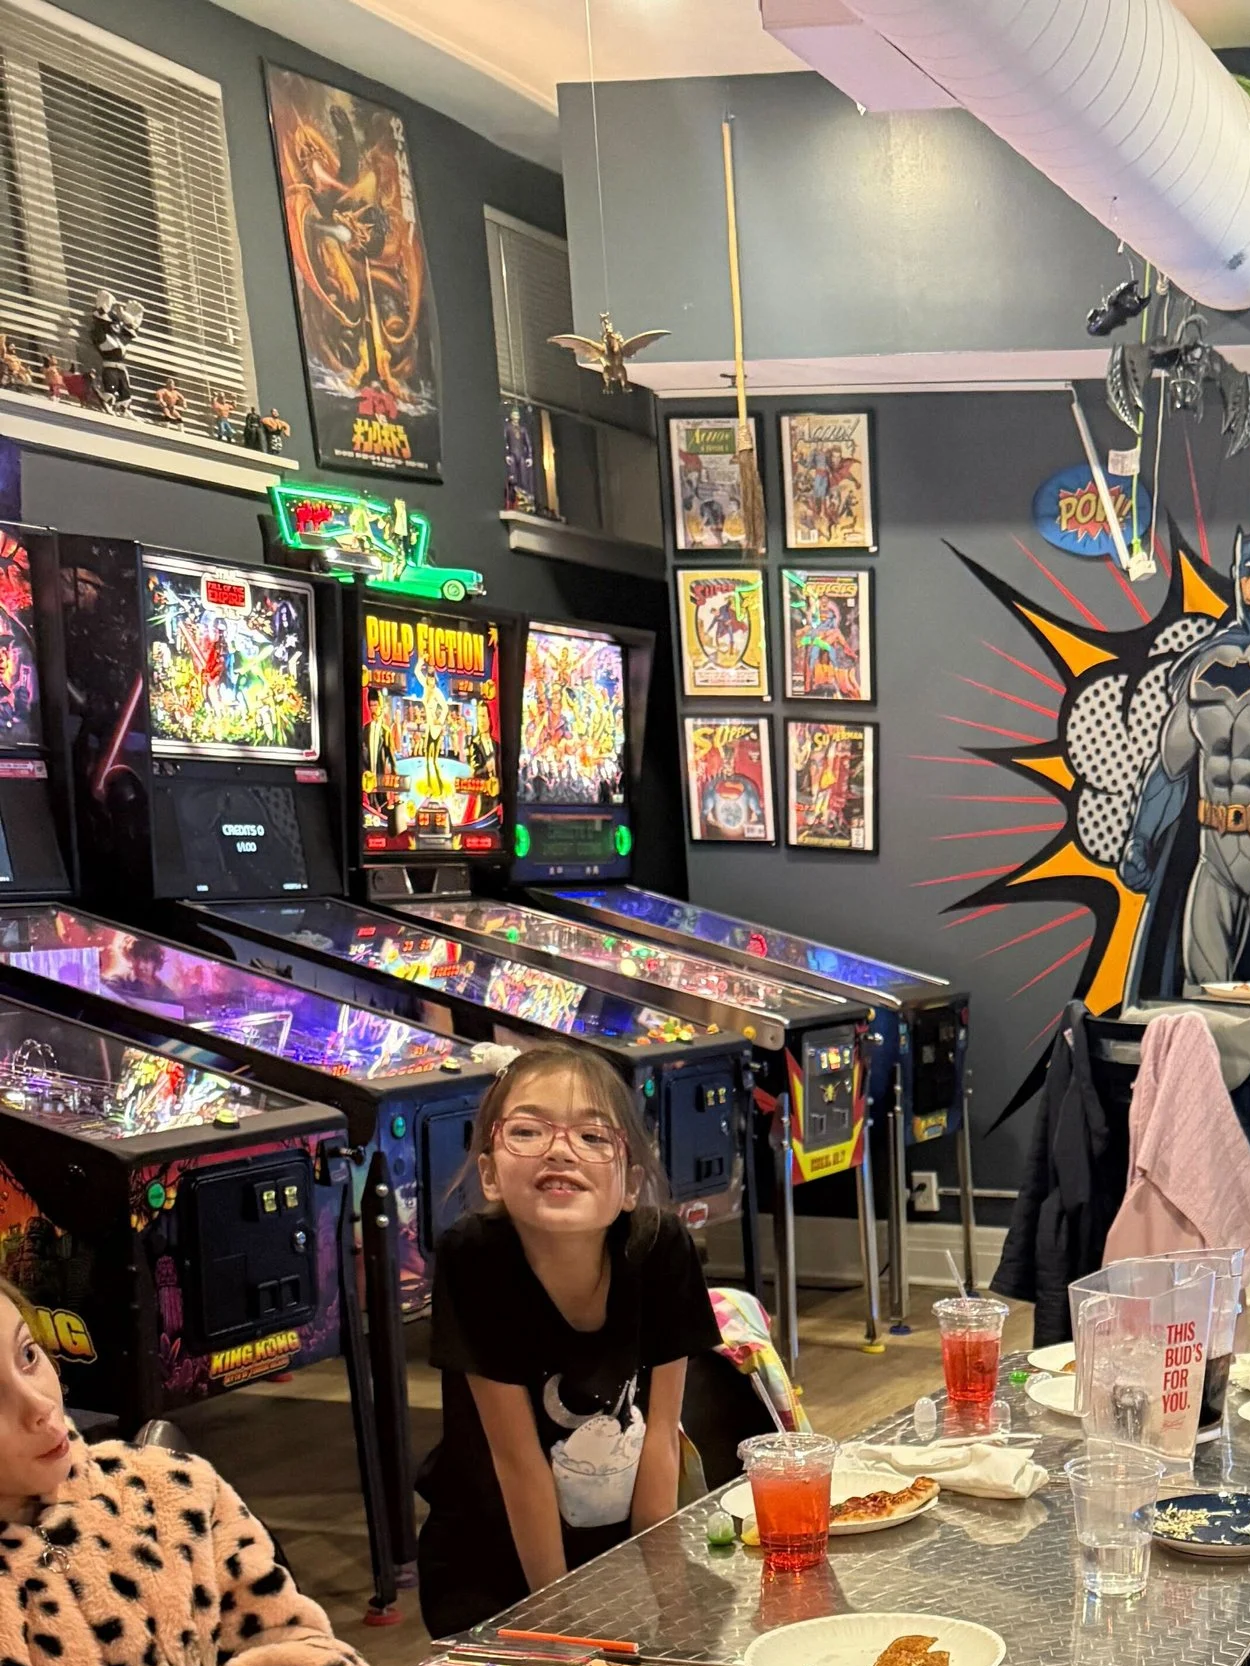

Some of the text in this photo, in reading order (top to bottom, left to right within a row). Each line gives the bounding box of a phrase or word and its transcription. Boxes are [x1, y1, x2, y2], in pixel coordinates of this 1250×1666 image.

[366, 615, 485, 674] PULP FICTION
[222, 824, 257, 836] CREDITS
[1166, 1321, 1196, 1345] THIS
[211, 1331, 300, 1375] KING KONG
[1165, 1342, 1203, 1368] BUD'S
[1163, 1368, 1189, 1391] FOR
[1162, 1391, 1191, 1414] YOU.
